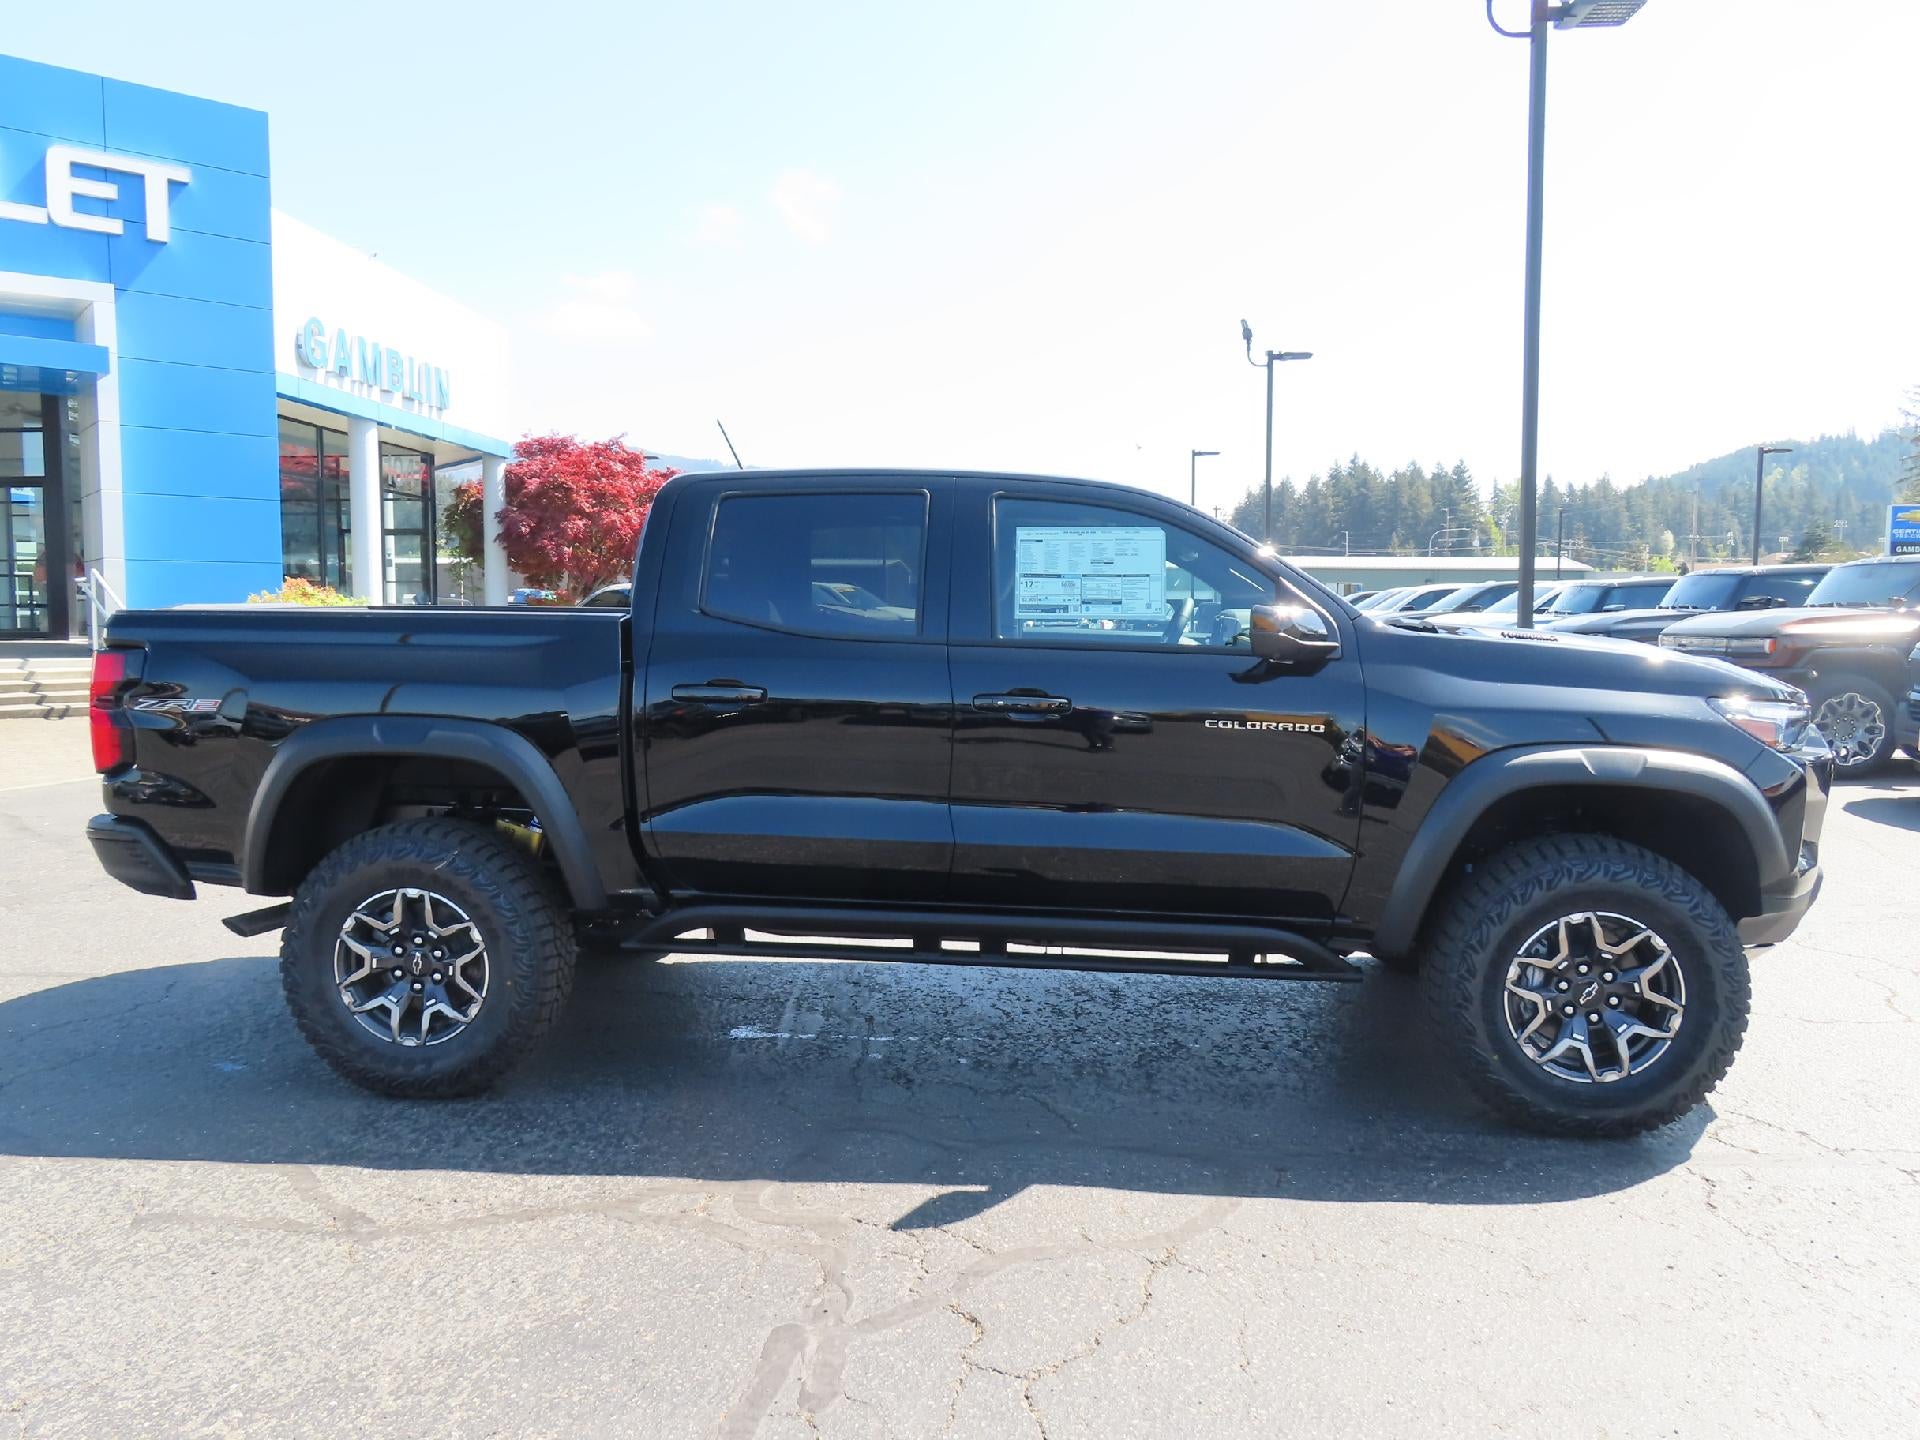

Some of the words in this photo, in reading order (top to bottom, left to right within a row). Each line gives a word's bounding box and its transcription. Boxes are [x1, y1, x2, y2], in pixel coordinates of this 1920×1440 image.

[297, 315, 450, 411] GAMBLIN
[134, 698, 222, 711] ZR2
[1204, 719, 1325, 733] COLORADO
